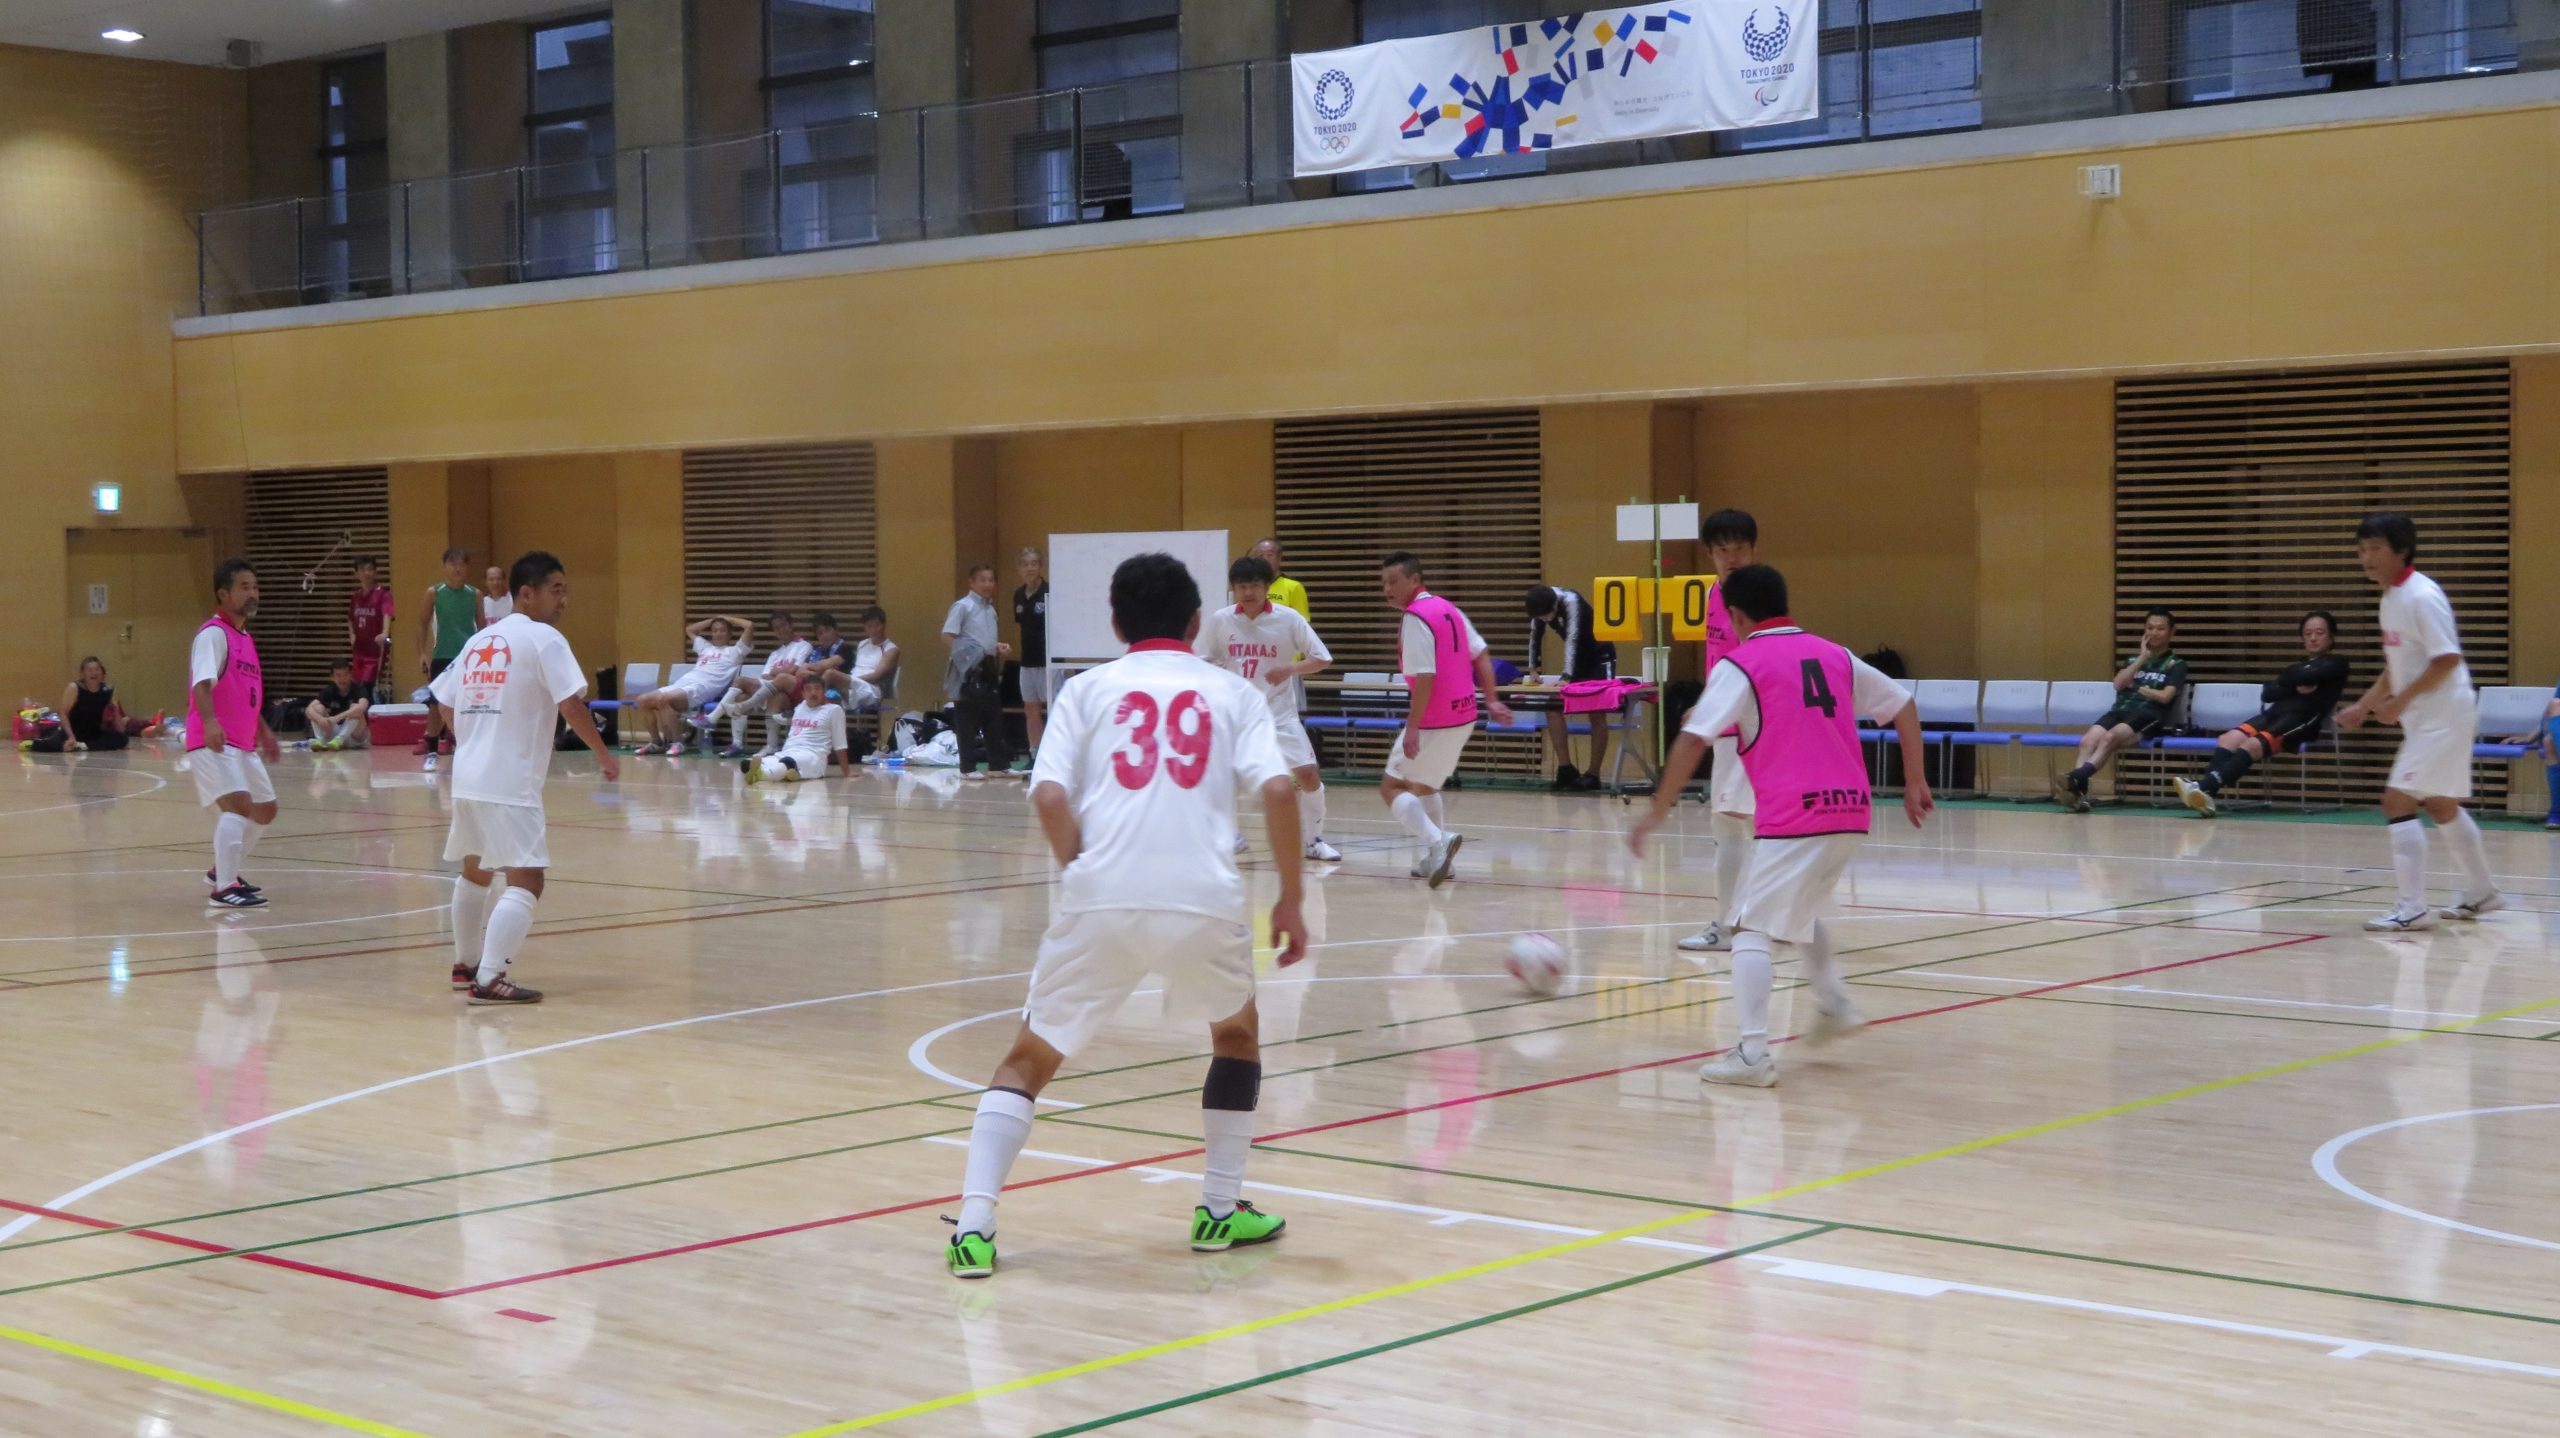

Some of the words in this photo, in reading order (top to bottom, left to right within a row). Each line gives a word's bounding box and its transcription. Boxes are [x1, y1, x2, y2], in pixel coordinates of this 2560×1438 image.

[1740, 67, 1770, 79] TOKYO
[1771, 62, 1795, 76] 2020
[1313, 125, 1337, 135] TOKYO
[1338, 122, 1357, 133] 2020
[1605, 580, 1625, 626] 0
[1684, 579, 1705, 626] 0
[1242, 658, 1259, 678] 17
[1801, 658, 1838, 718] 4
[1111, 689, 1211, 790] 39
